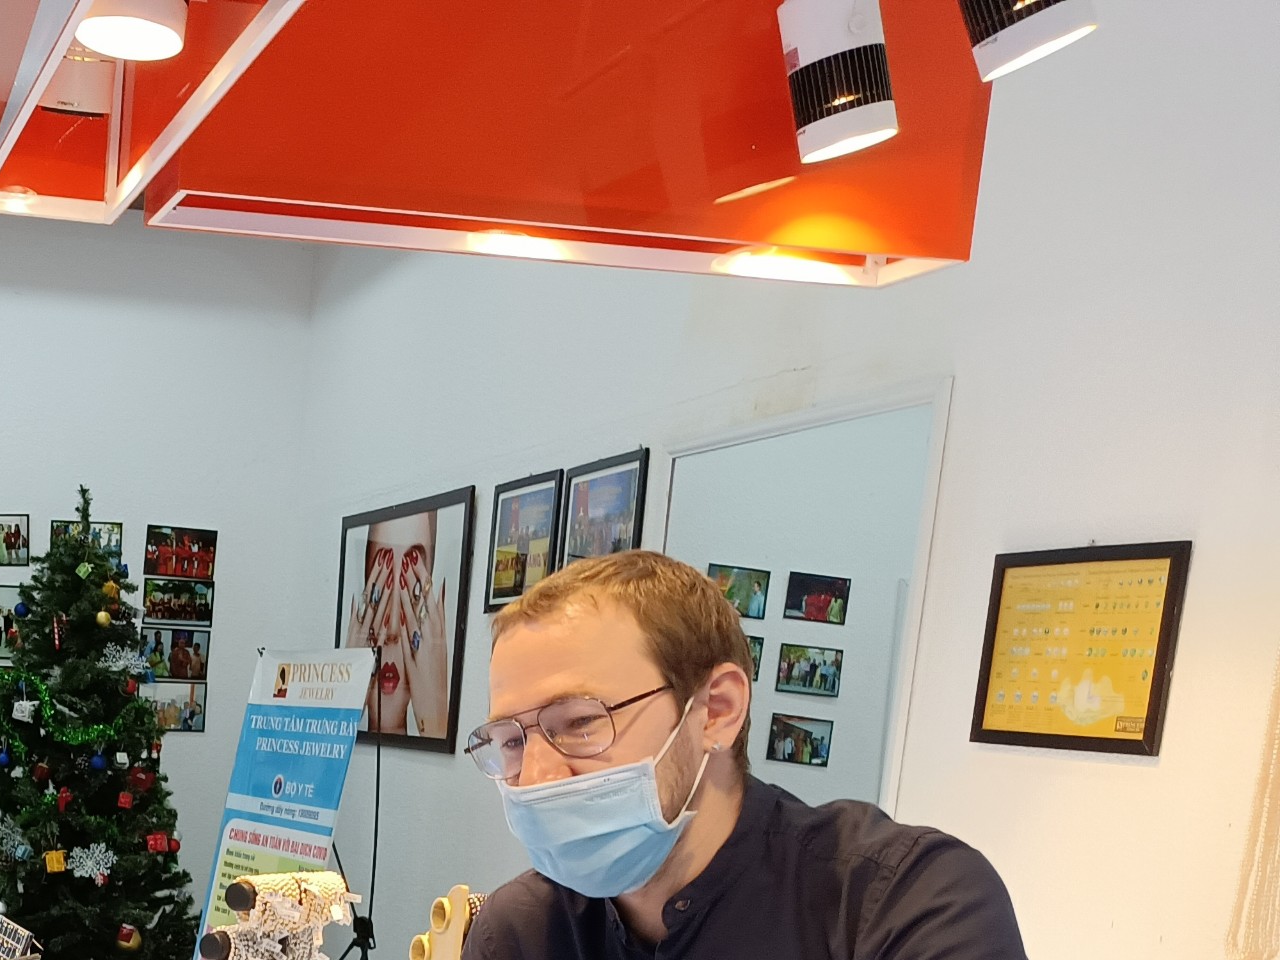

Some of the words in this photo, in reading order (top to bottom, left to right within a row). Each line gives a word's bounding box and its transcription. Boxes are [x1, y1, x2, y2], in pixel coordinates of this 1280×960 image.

[291, 663, 352, 683] PRINCESS
[299, 687, 335, 701] JEWELRY
[250, 715, 282, 730] TRUNG
[255, 737, 299, 754] PRINCESS
[300, 741, 347, 759] JEWELRY
[298, 783, 304, 796] Y
